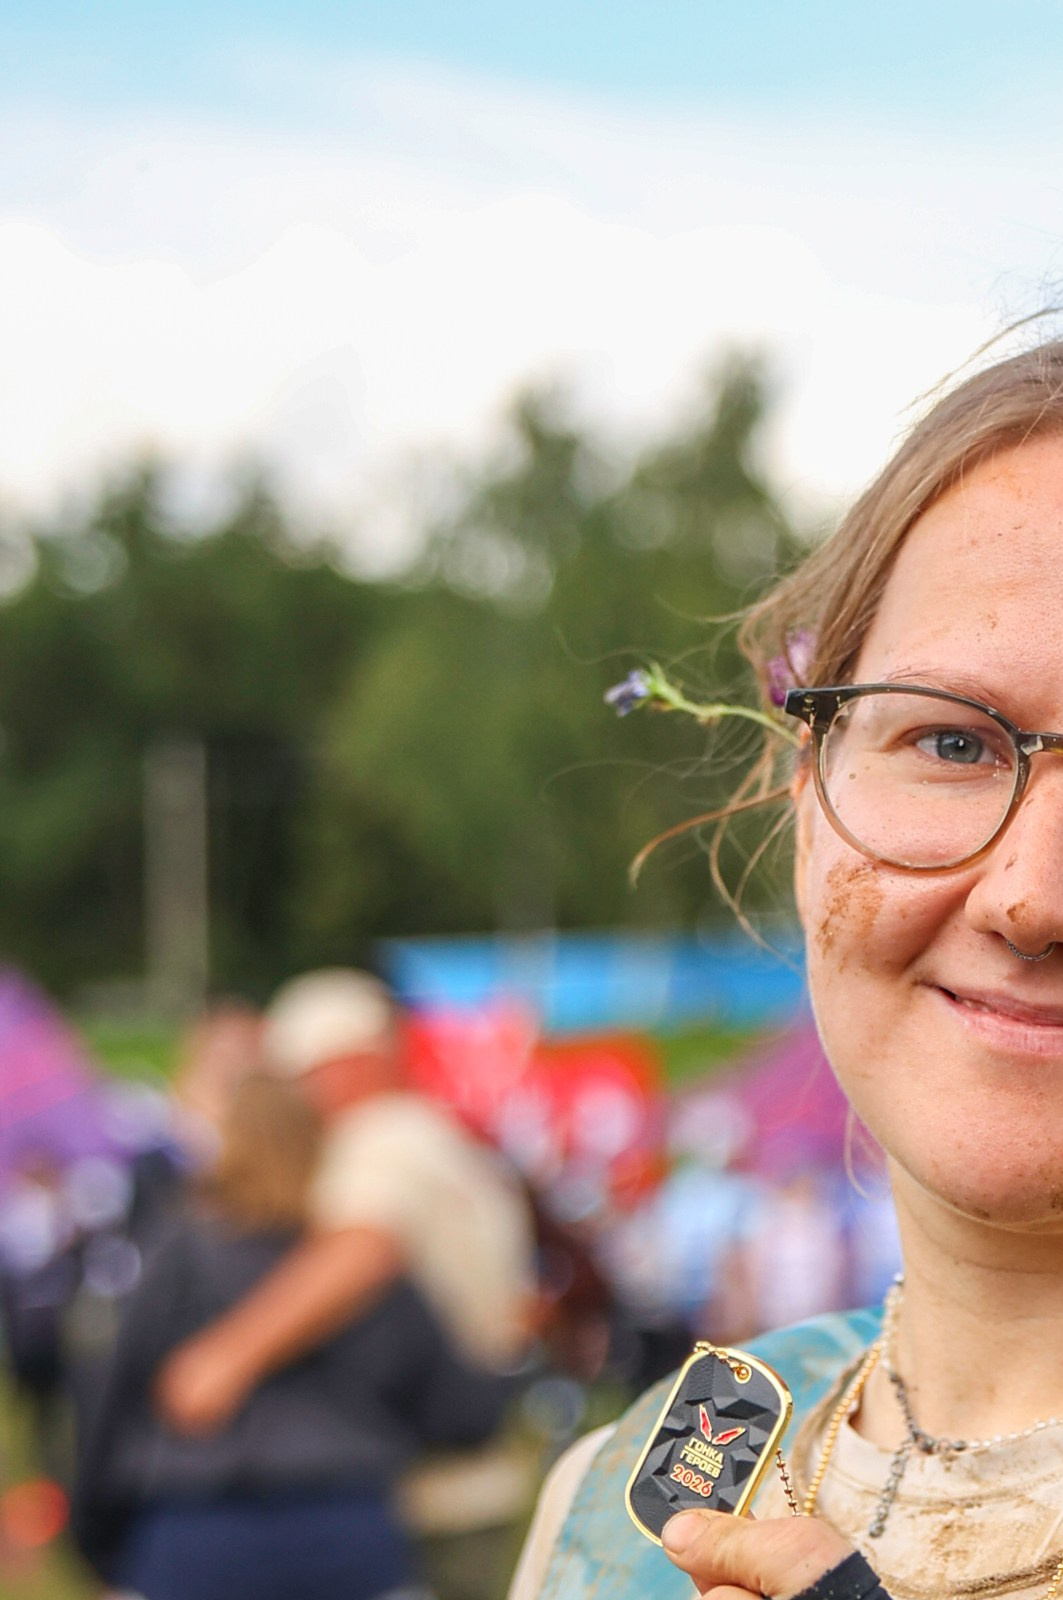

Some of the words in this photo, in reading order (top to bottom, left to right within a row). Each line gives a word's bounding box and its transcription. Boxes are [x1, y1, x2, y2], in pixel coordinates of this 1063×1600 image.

[680, 1449, 721, 1479] ГЕРОЕВ
[688, 1437, 724, 1463] ГОНКА
[670, 1464, 714, 1498] 2026
